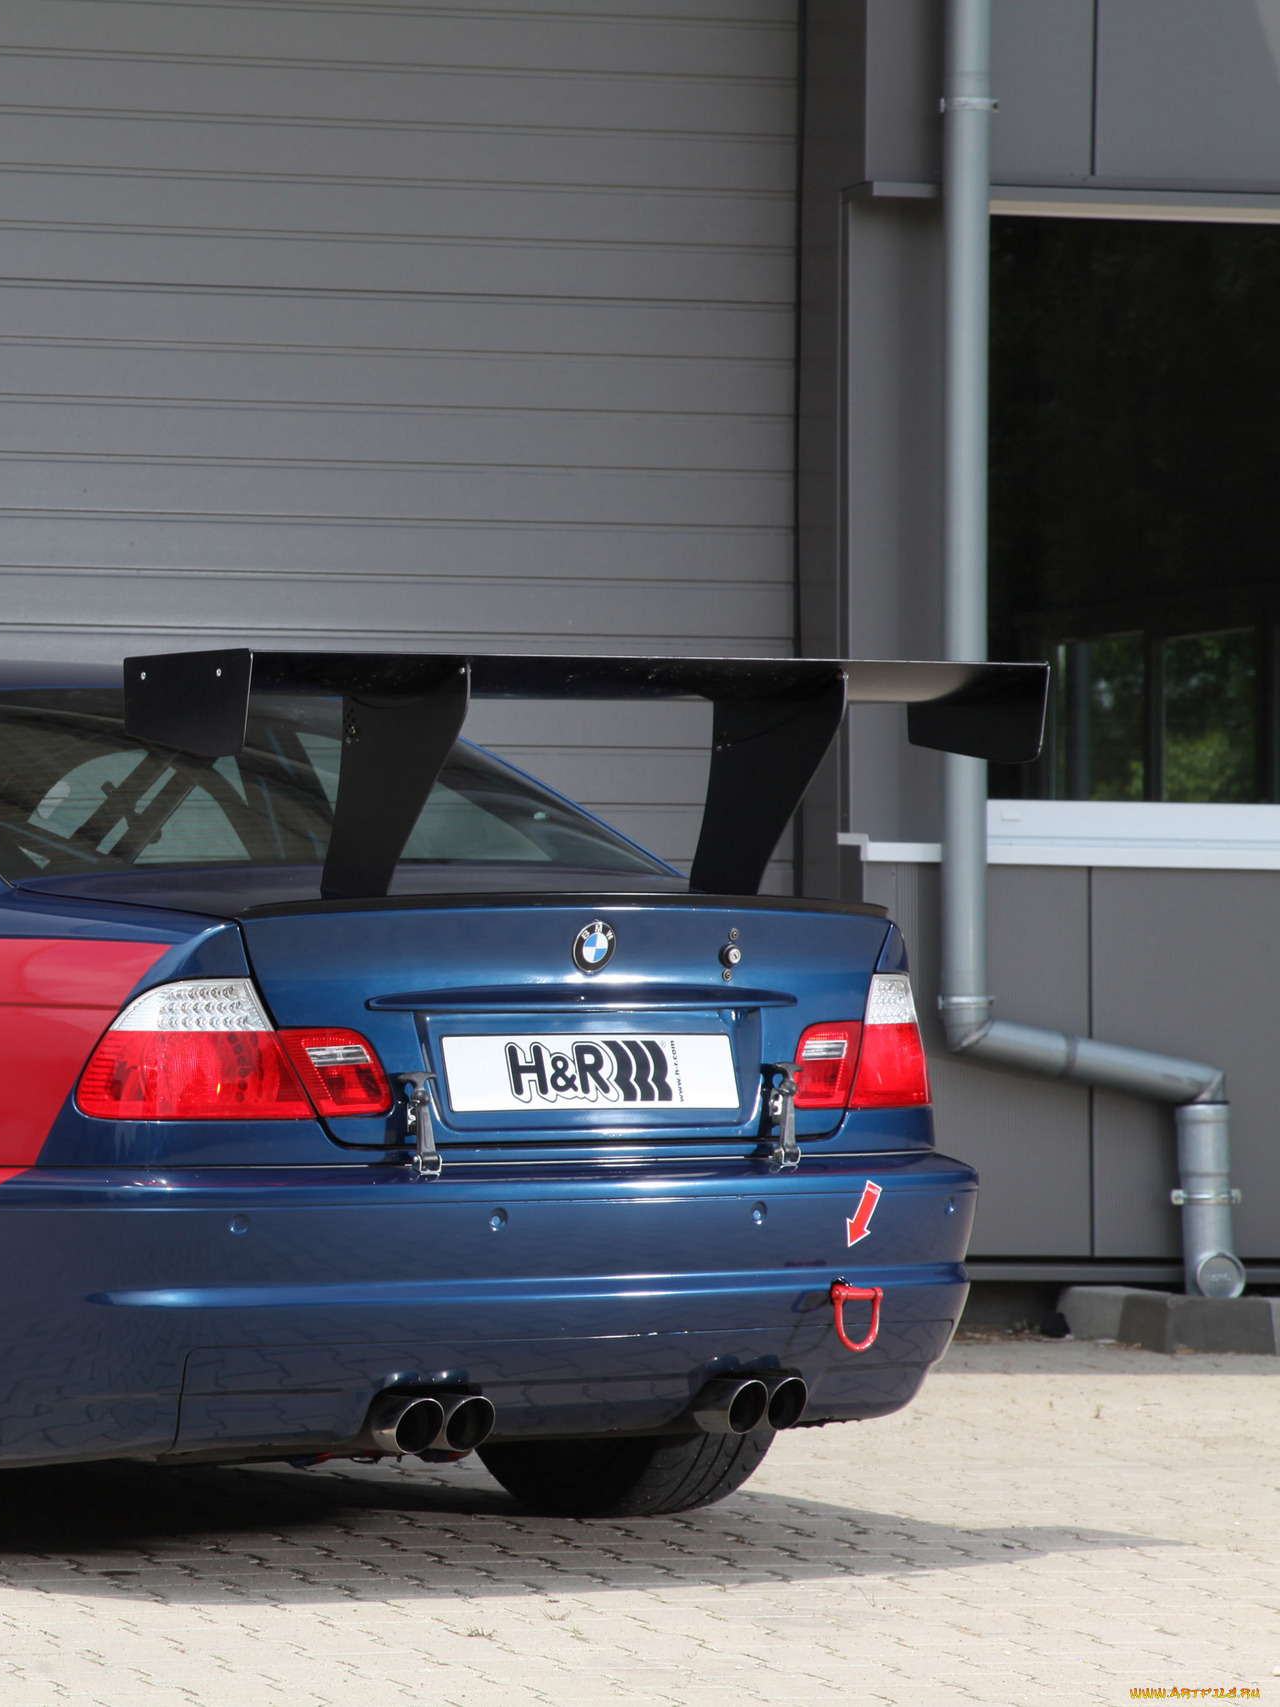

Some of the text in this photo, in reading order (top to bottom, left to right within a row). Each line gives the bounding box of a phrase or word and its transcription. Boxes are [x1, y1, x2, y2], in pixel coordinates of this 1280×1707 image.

[581, 923, 614, 940] BMW
[505, 1041, 619, 1102] H&R
[670, 1040, 684, 1102] www.h-r.com
